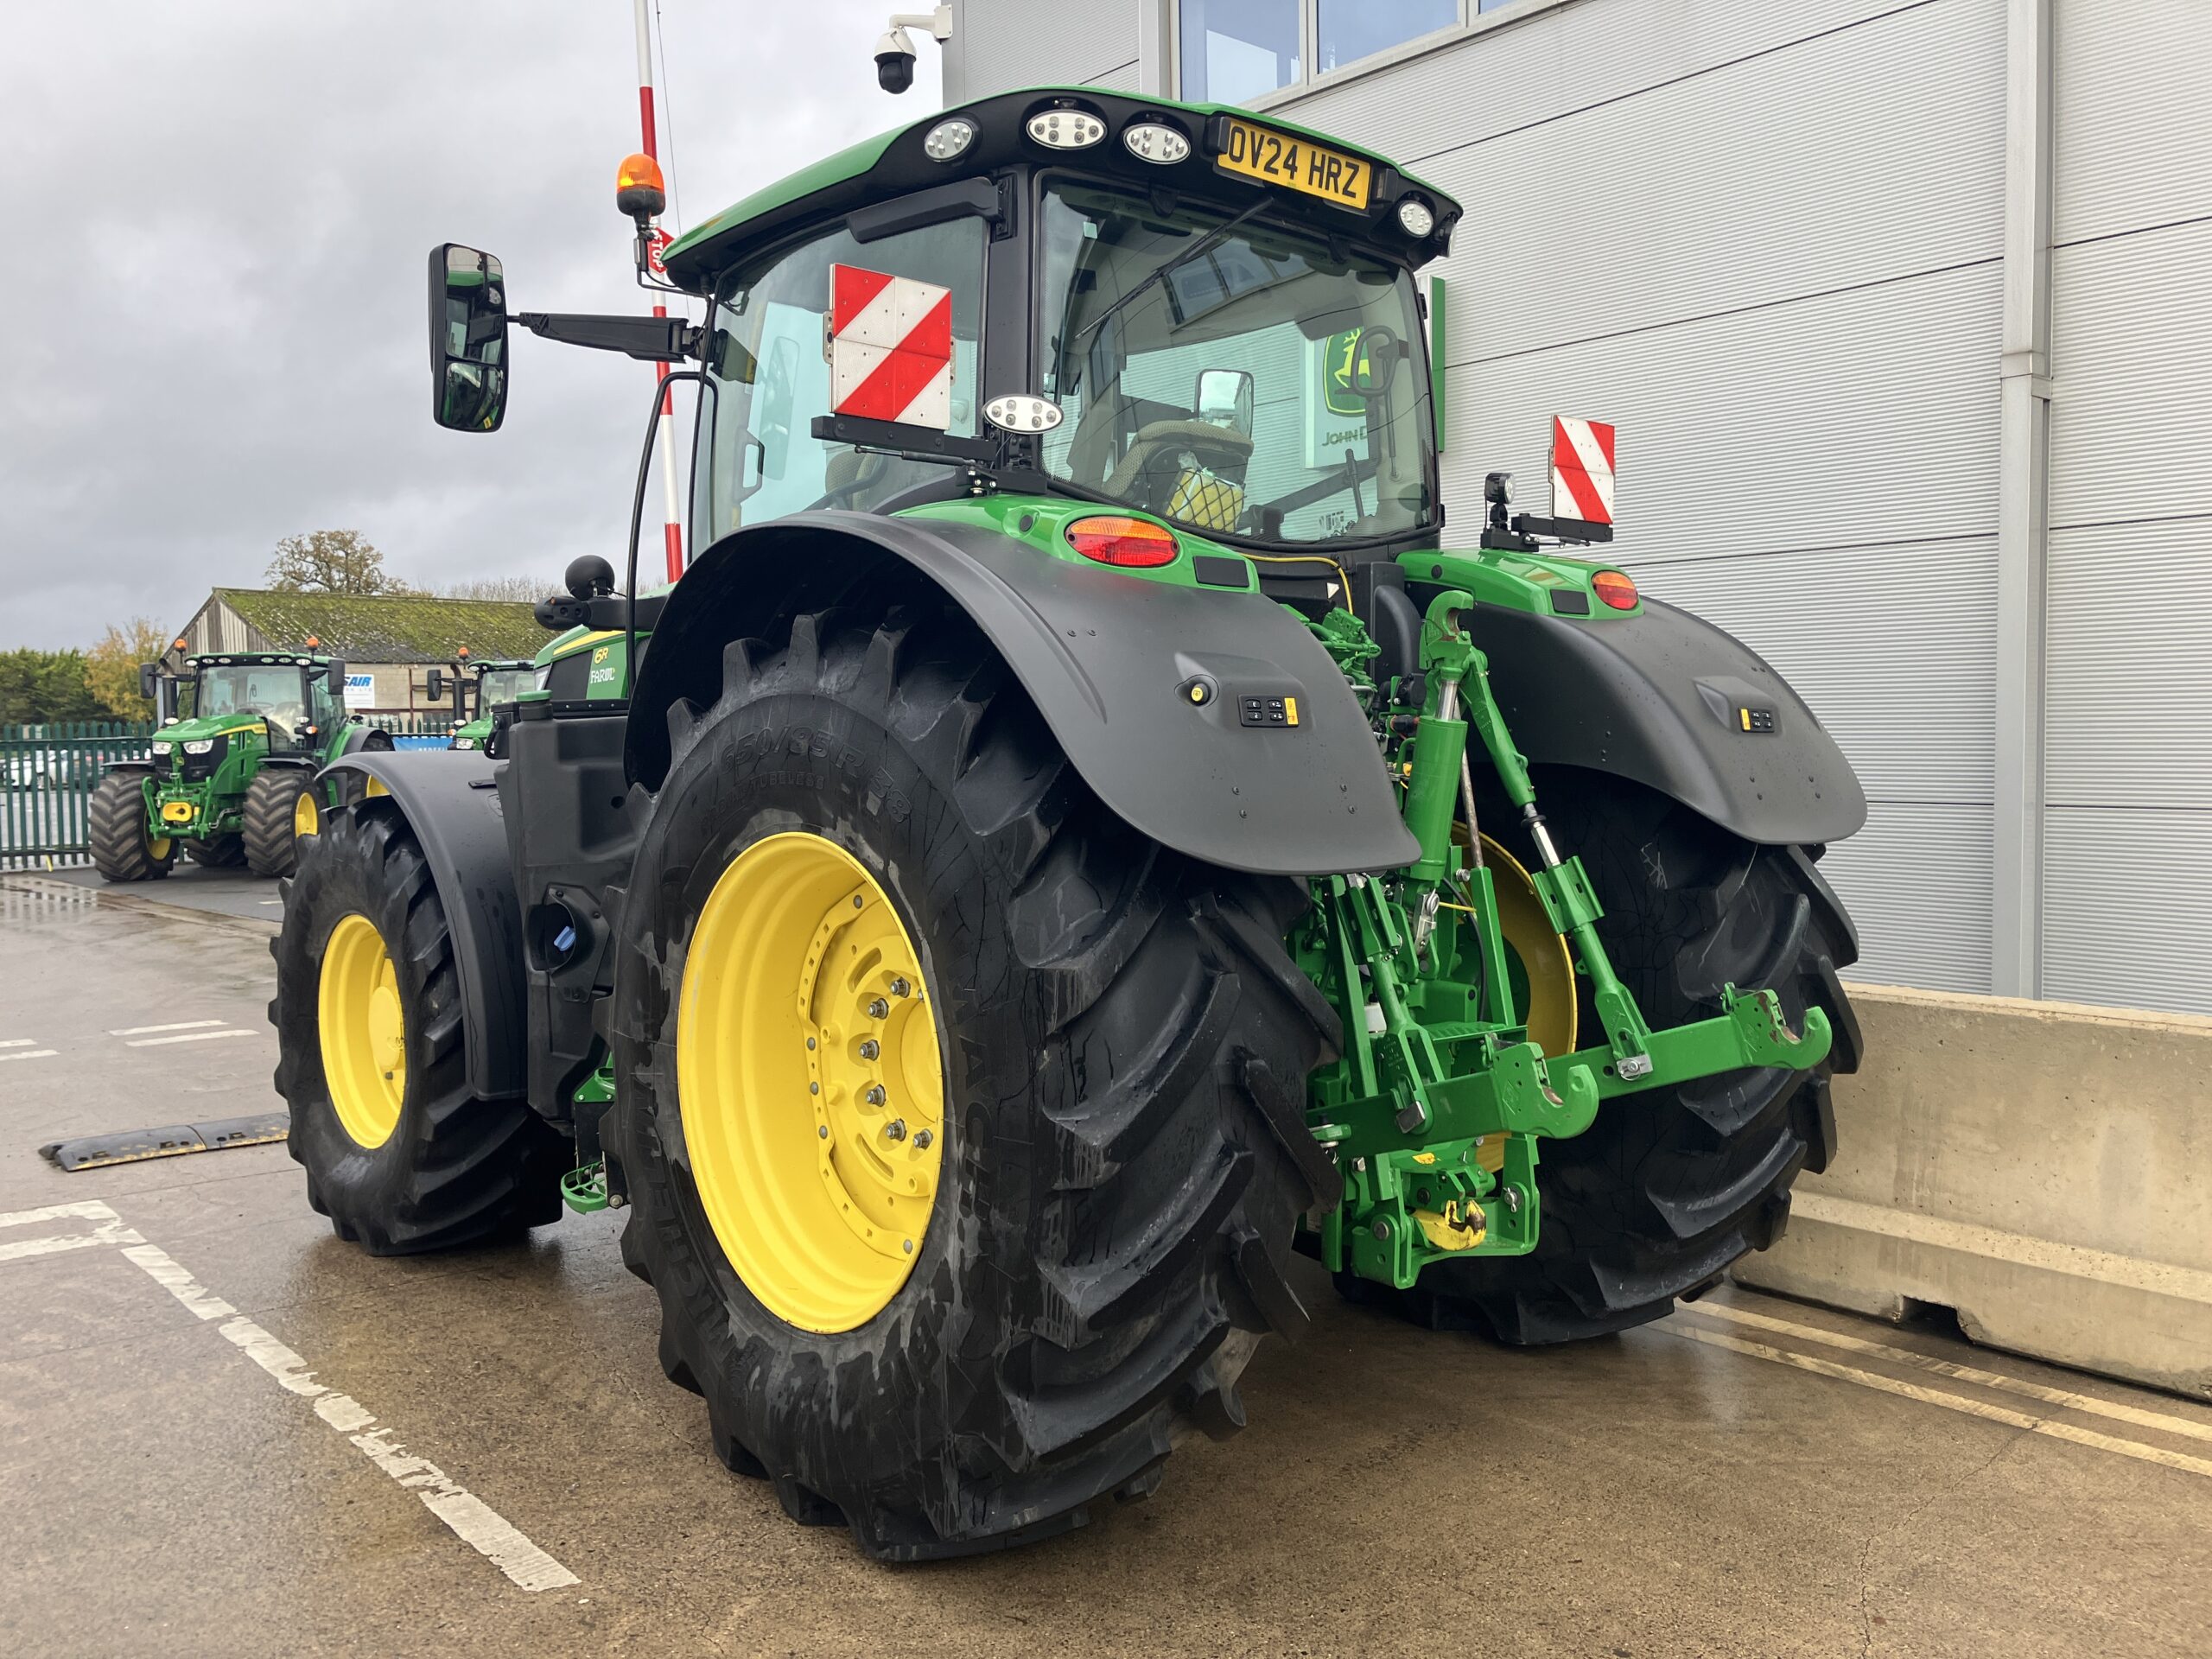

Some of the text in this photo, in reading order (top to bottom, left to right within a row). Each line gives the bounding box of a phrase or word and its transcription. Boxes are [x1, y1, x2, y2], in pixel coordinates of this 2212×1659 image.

[1228, 126, 1360, 199] OV24 HRZ
[1322, 429, 1357, 446] JOHN
[594, 647, 609, 664] 6R
